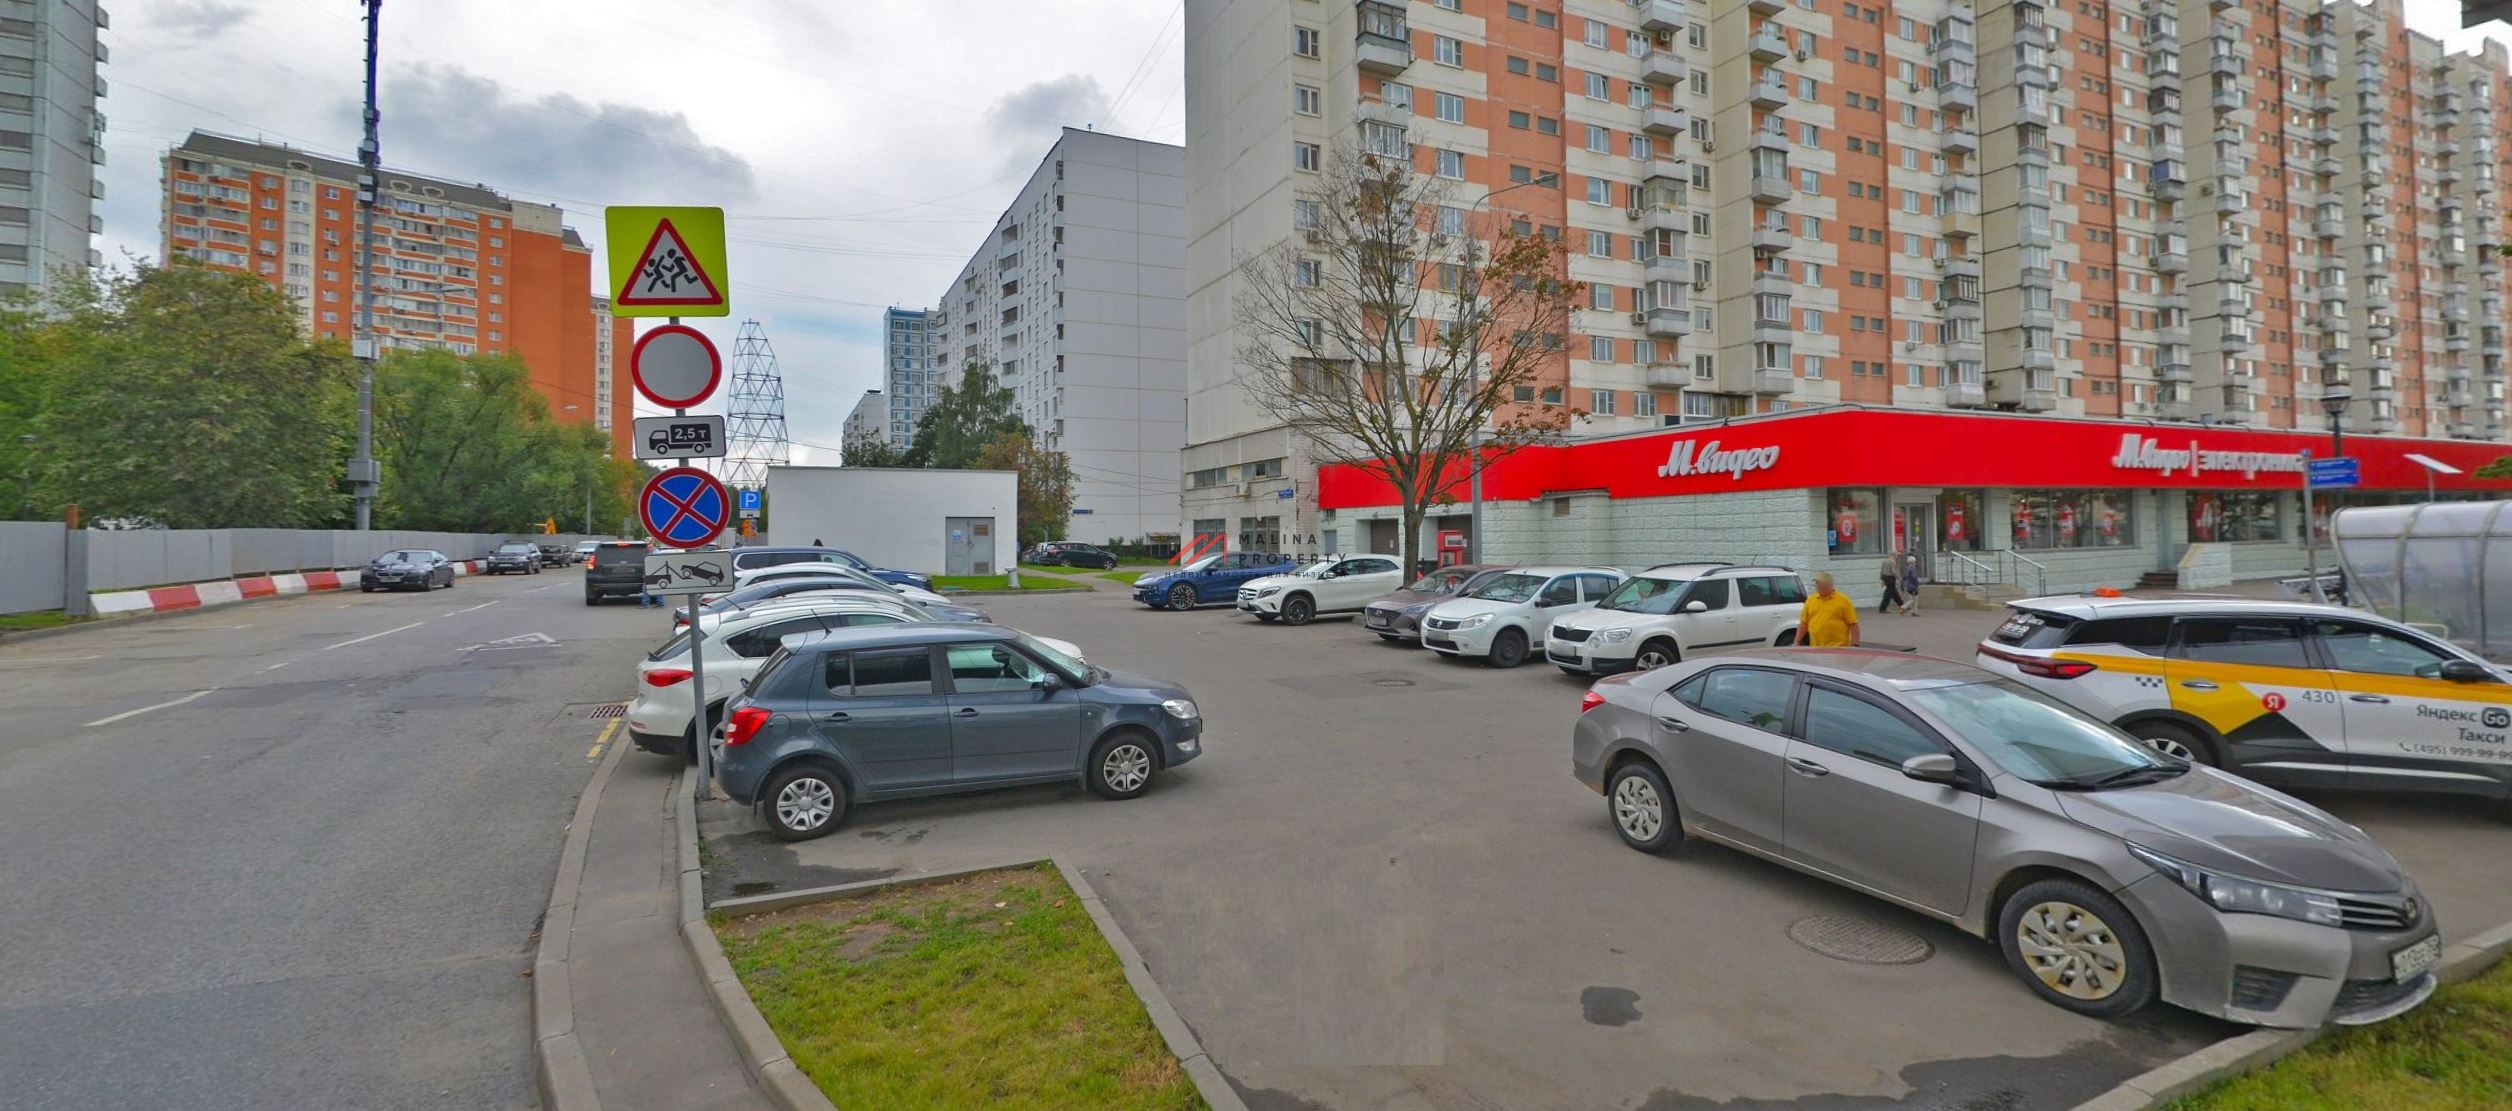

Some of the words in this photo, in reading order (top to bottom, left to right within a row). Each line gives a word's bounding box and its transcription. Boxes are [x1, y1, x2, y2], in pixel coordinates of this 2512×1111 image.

[674, 428, 696, 441] 2,5
[1657, 439, 1780, 480] М.видео
[745, 493, 757, 507] P
[2267, 694, 2279, 709] Я
[2302, 690, 2335, 704] 430
[2416, 704, 2479, 722] Яндекс
[2458, 728, 2506, 744] Такси
[2414, 744, 2447, 756] (495)
